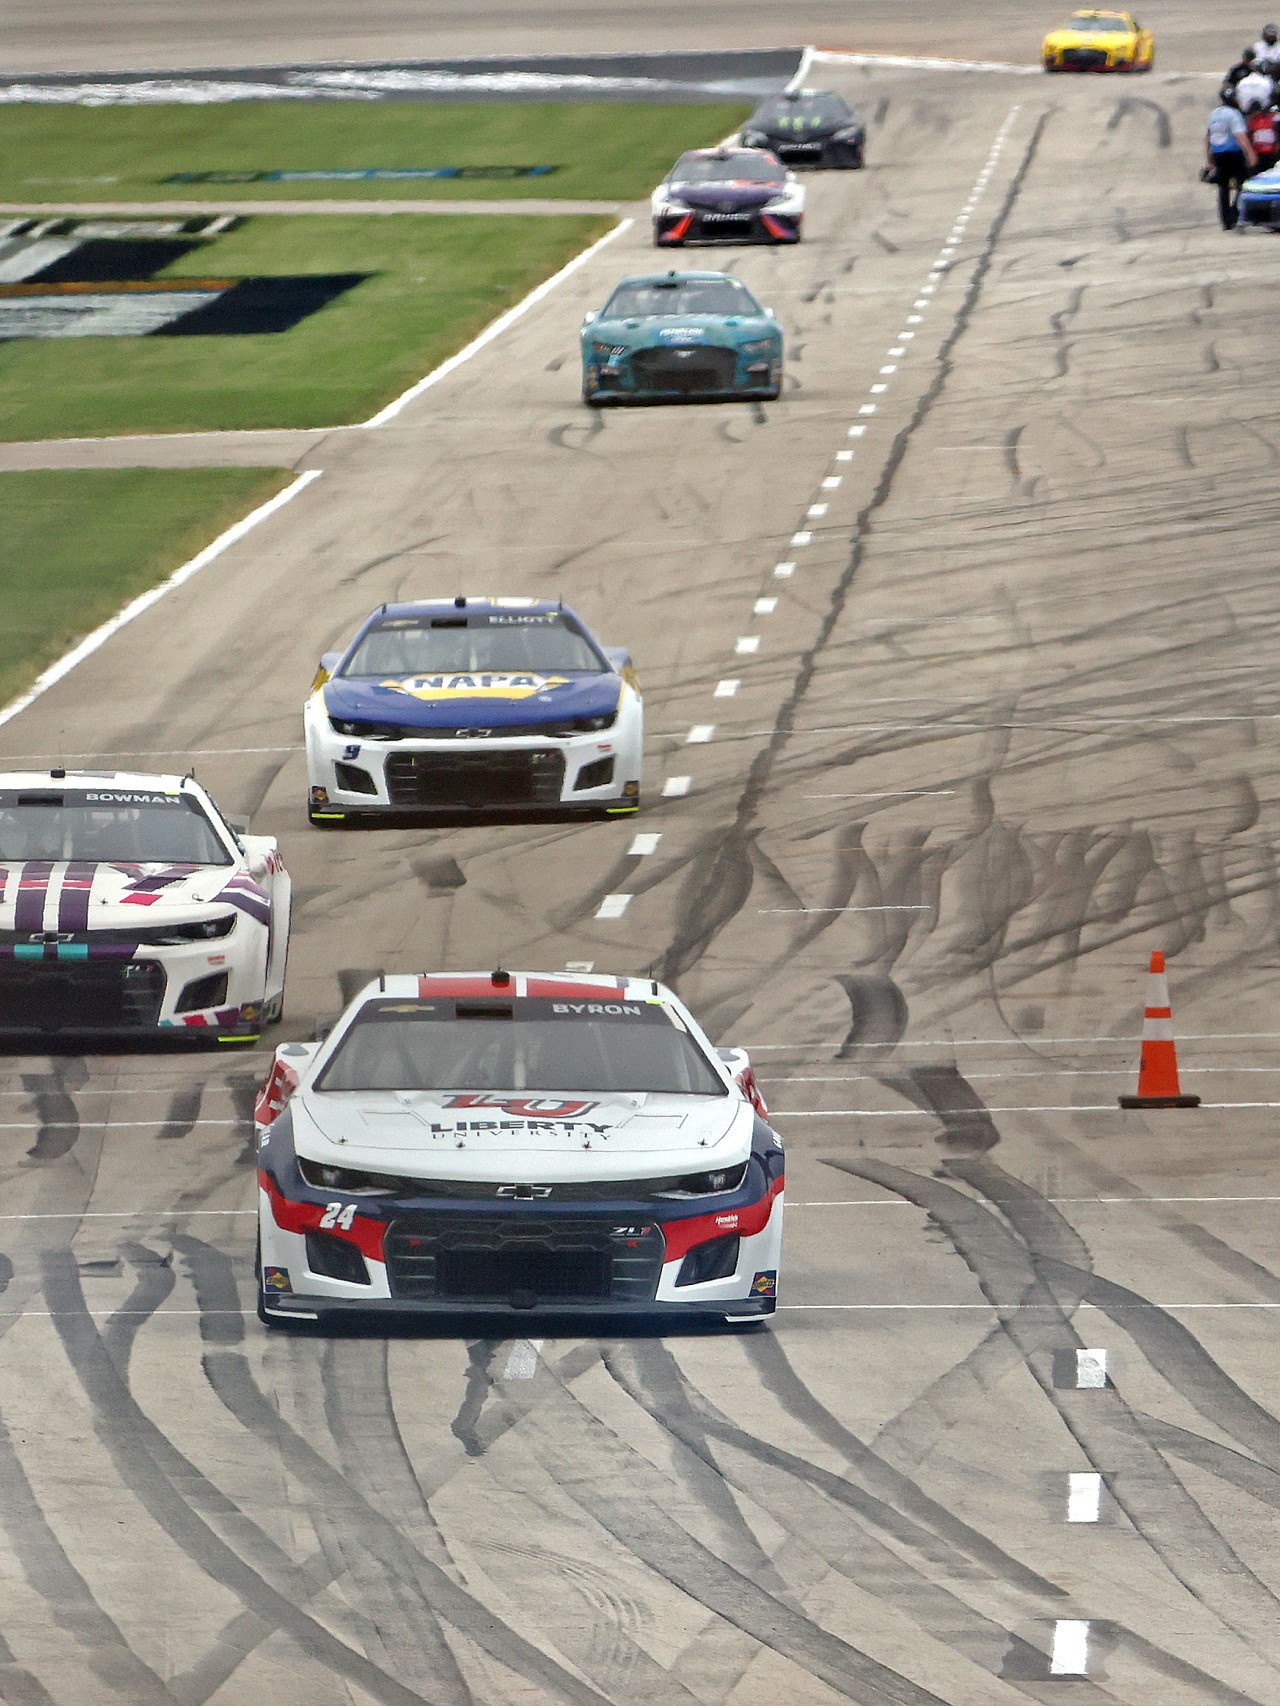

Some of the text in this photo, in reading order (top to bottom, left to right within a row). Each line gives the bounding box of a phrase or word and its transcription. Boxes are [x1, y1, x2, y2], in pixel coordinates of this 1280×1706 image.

[414, 674, 538, 689] NAPA
[342, 744, 361, 761] 9
[86, 793, 181, 804] BOWMAN
[552, 1003, 642, 1016] BYRON
[430, 1120, 613, 1133] LIBERTY
[431, 1129, 612, 1141] UNIVERSITY
[319, 1202, 358, 1231] 24
